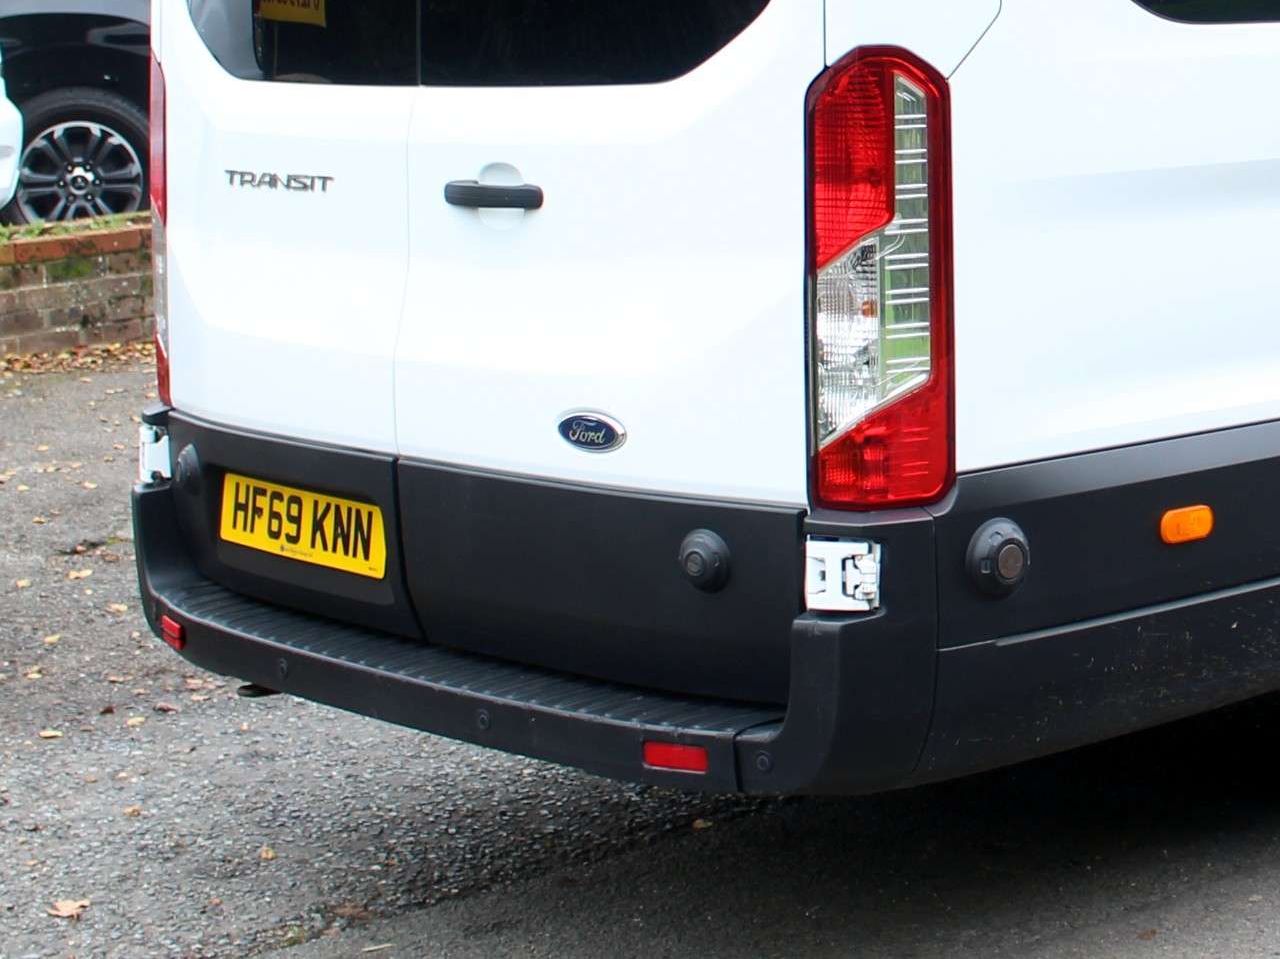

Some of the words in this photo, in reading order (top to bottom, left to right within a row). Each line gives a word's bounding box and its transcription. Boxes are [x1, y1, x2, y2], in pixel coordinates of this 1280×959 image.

[224, 169, 335, 192] TRANSIT
[569, 419, 606, 444] Ford
[232, 481, 303, 545] HF69
[310, 499, 373, 562] KNN
